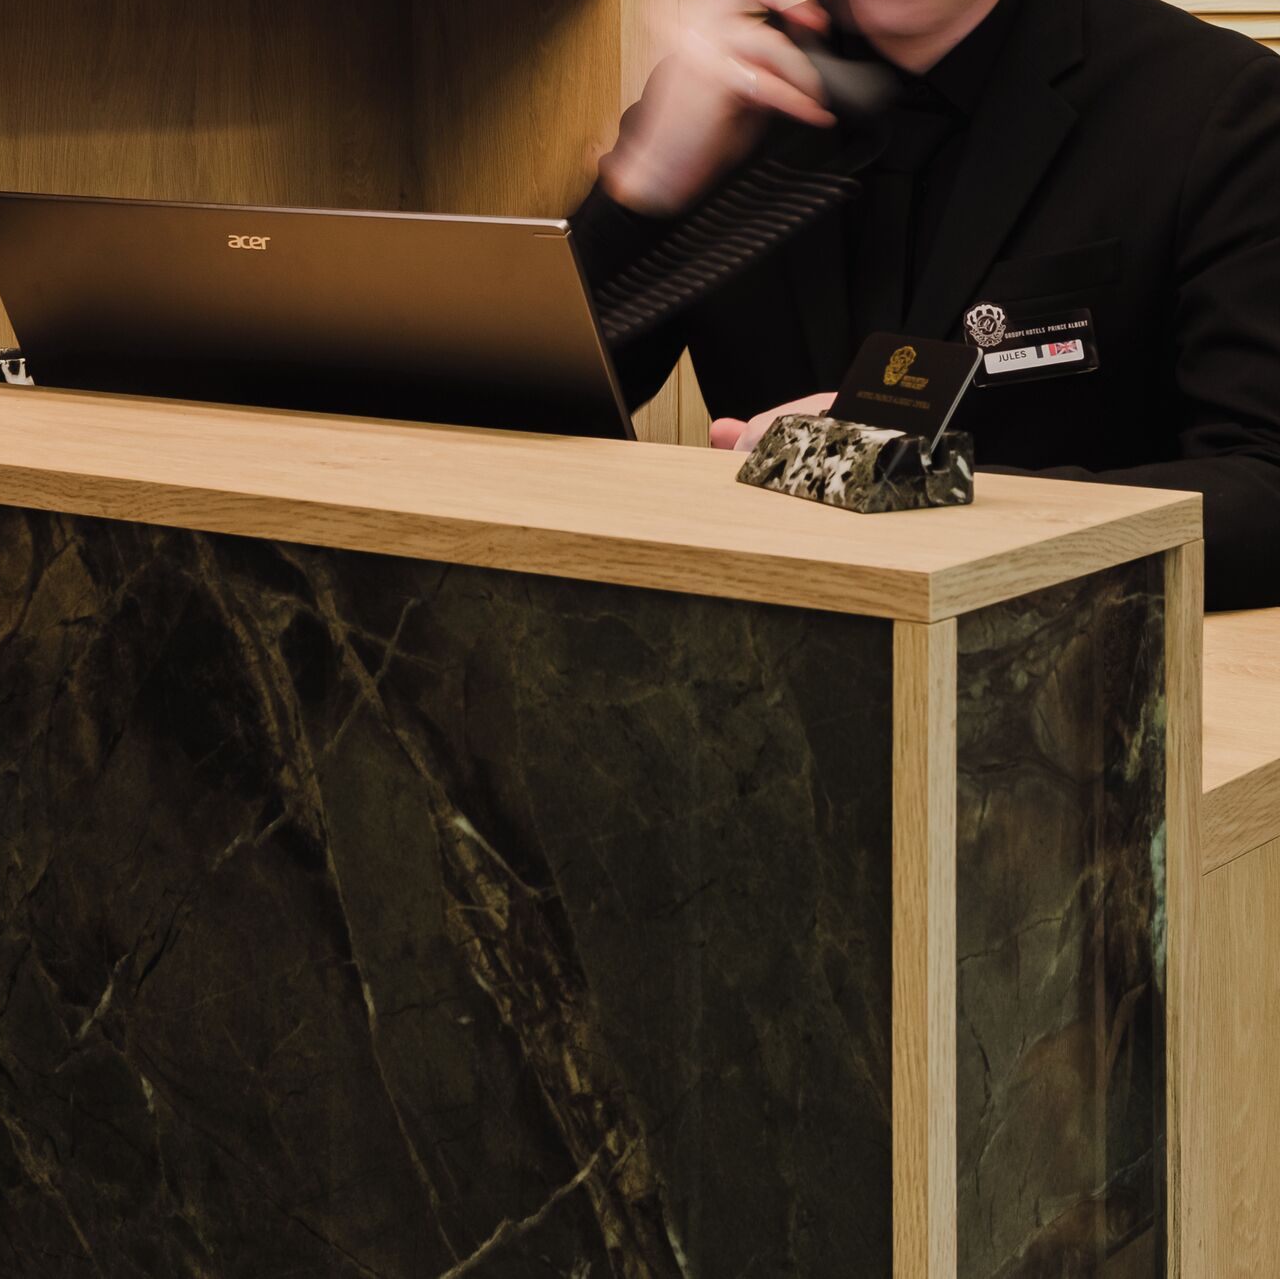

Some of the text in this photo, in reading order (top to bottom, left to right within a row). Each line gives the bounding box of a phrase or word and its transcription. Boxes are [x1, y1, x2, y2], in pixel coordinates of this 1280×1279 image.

[228, 235, 271, 250] acer
[1004, 320, 1088, 339] GROUPE HOTELS PRINCE ALBERT
[999, 350, 1027, 362] JULES
